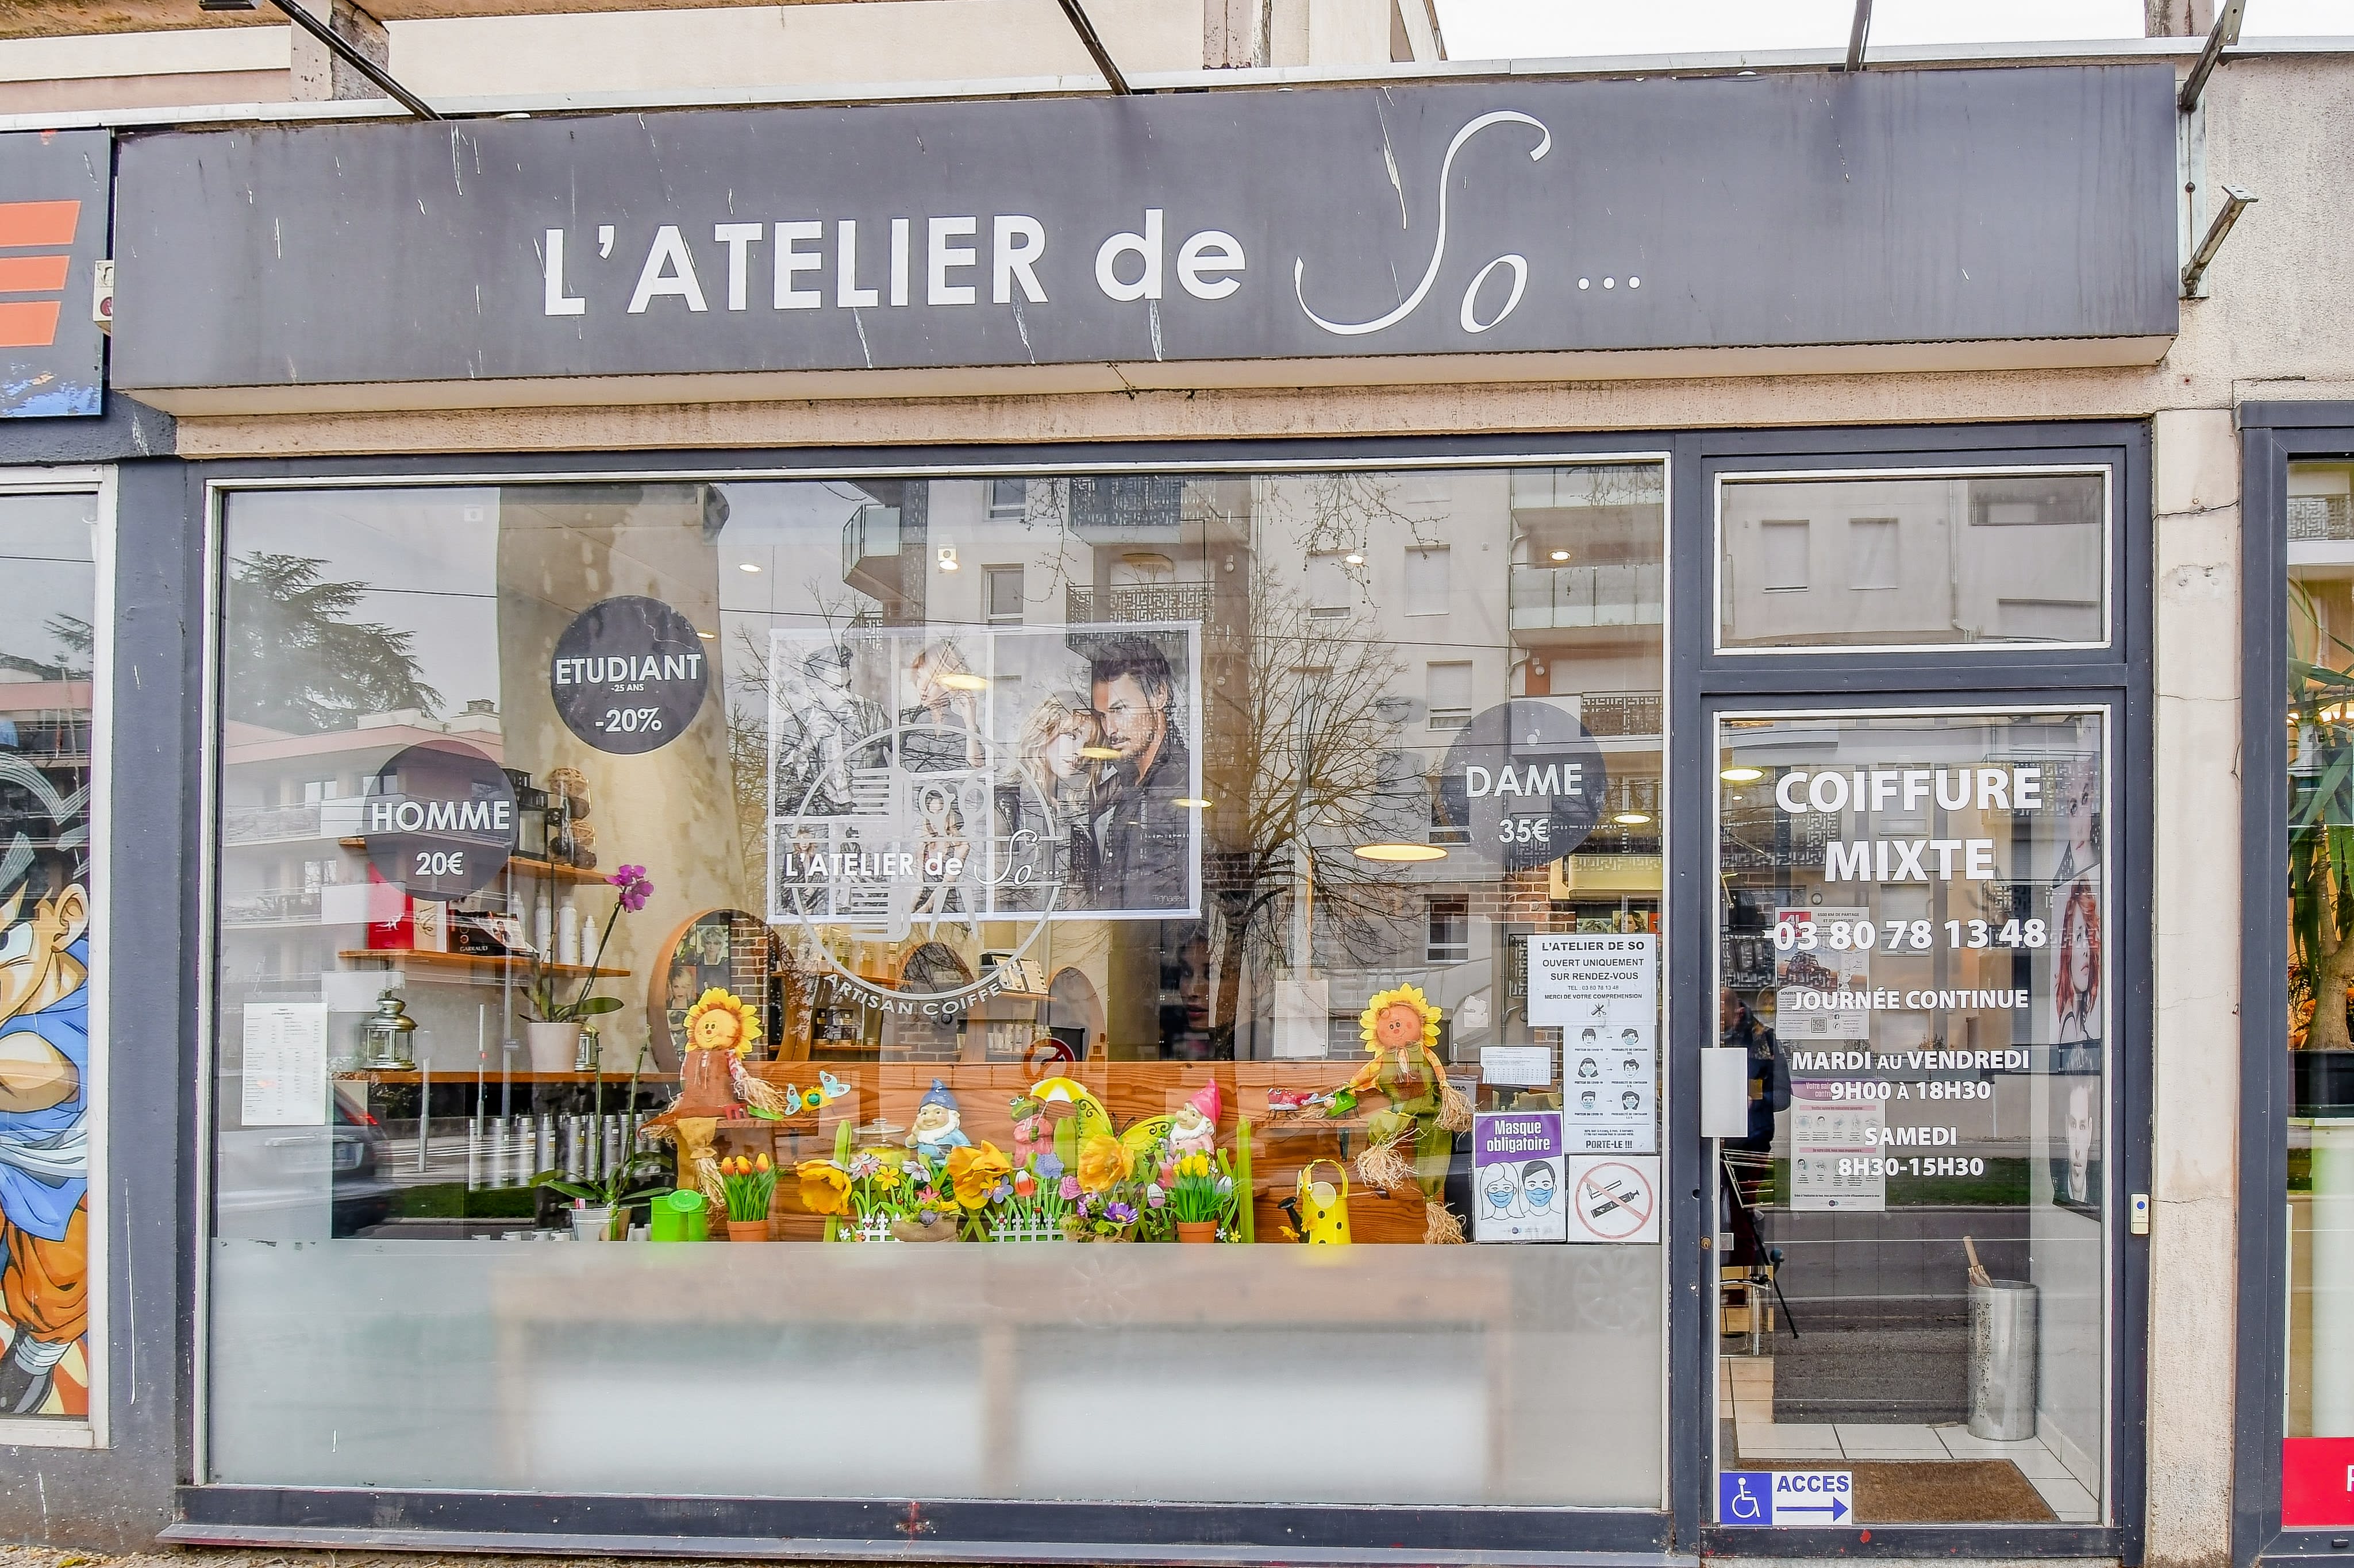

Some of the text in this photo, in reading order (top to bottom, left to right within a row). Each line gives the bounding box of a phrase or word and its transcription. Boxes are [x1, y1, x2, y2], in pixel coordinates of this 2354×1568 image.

[544, 214, 1049, 315] L'ATELIER
[1095, 208, 1247, 302] de
[556, 653, 701, 685] ETUDIANT
[610, 684, 644, 692] -25 ANS
[595, 707, 662, 733] -20%
[1466, 763, 1582, 798] DAME
[1775, 767, 2043, 814] COIFFURE
[371, 801, 510, 831] HOMME
[1498, 818, 1551, 843] 35€
[415, 852, 464, 876] 20€
[925, 852, 964, 876] de
[1824, 838, 1995, 883] MIXTE
[1541, 941, 1645, 951] L'ATELIER DE SO
[1774, 918, 2047, 950] 03 80 78 13 48
[1543, 958, 1644, 967] OUVERT UNIQUEMENT
[1550, 972, 1638, 981] SUR RENDEZ-VOUS
[824, 973, 913, 1015] ARTISAN
[1791, 986, 1900, 1010] JOURNÉE
[1905, 989, 2029, 1009] CONTINUE
[1791, 1049, 2029, 1071] MARDI AU VENDREDI
[1830, 1080, 1991, 1100] 9H00 À 18H30
[1494, 1119, 1542, 1137] Masque
[1864, 1126, 1957, 1146] SAMEDI
[1486, 1136, 1551, 1153] obligatoire
[1586, 1140, 1623, 1148] PORTE-LE
[1837, 1157, 1984, 1177] 8H30-15H30
[1776, 1475, 1849, 1492] ACCES
